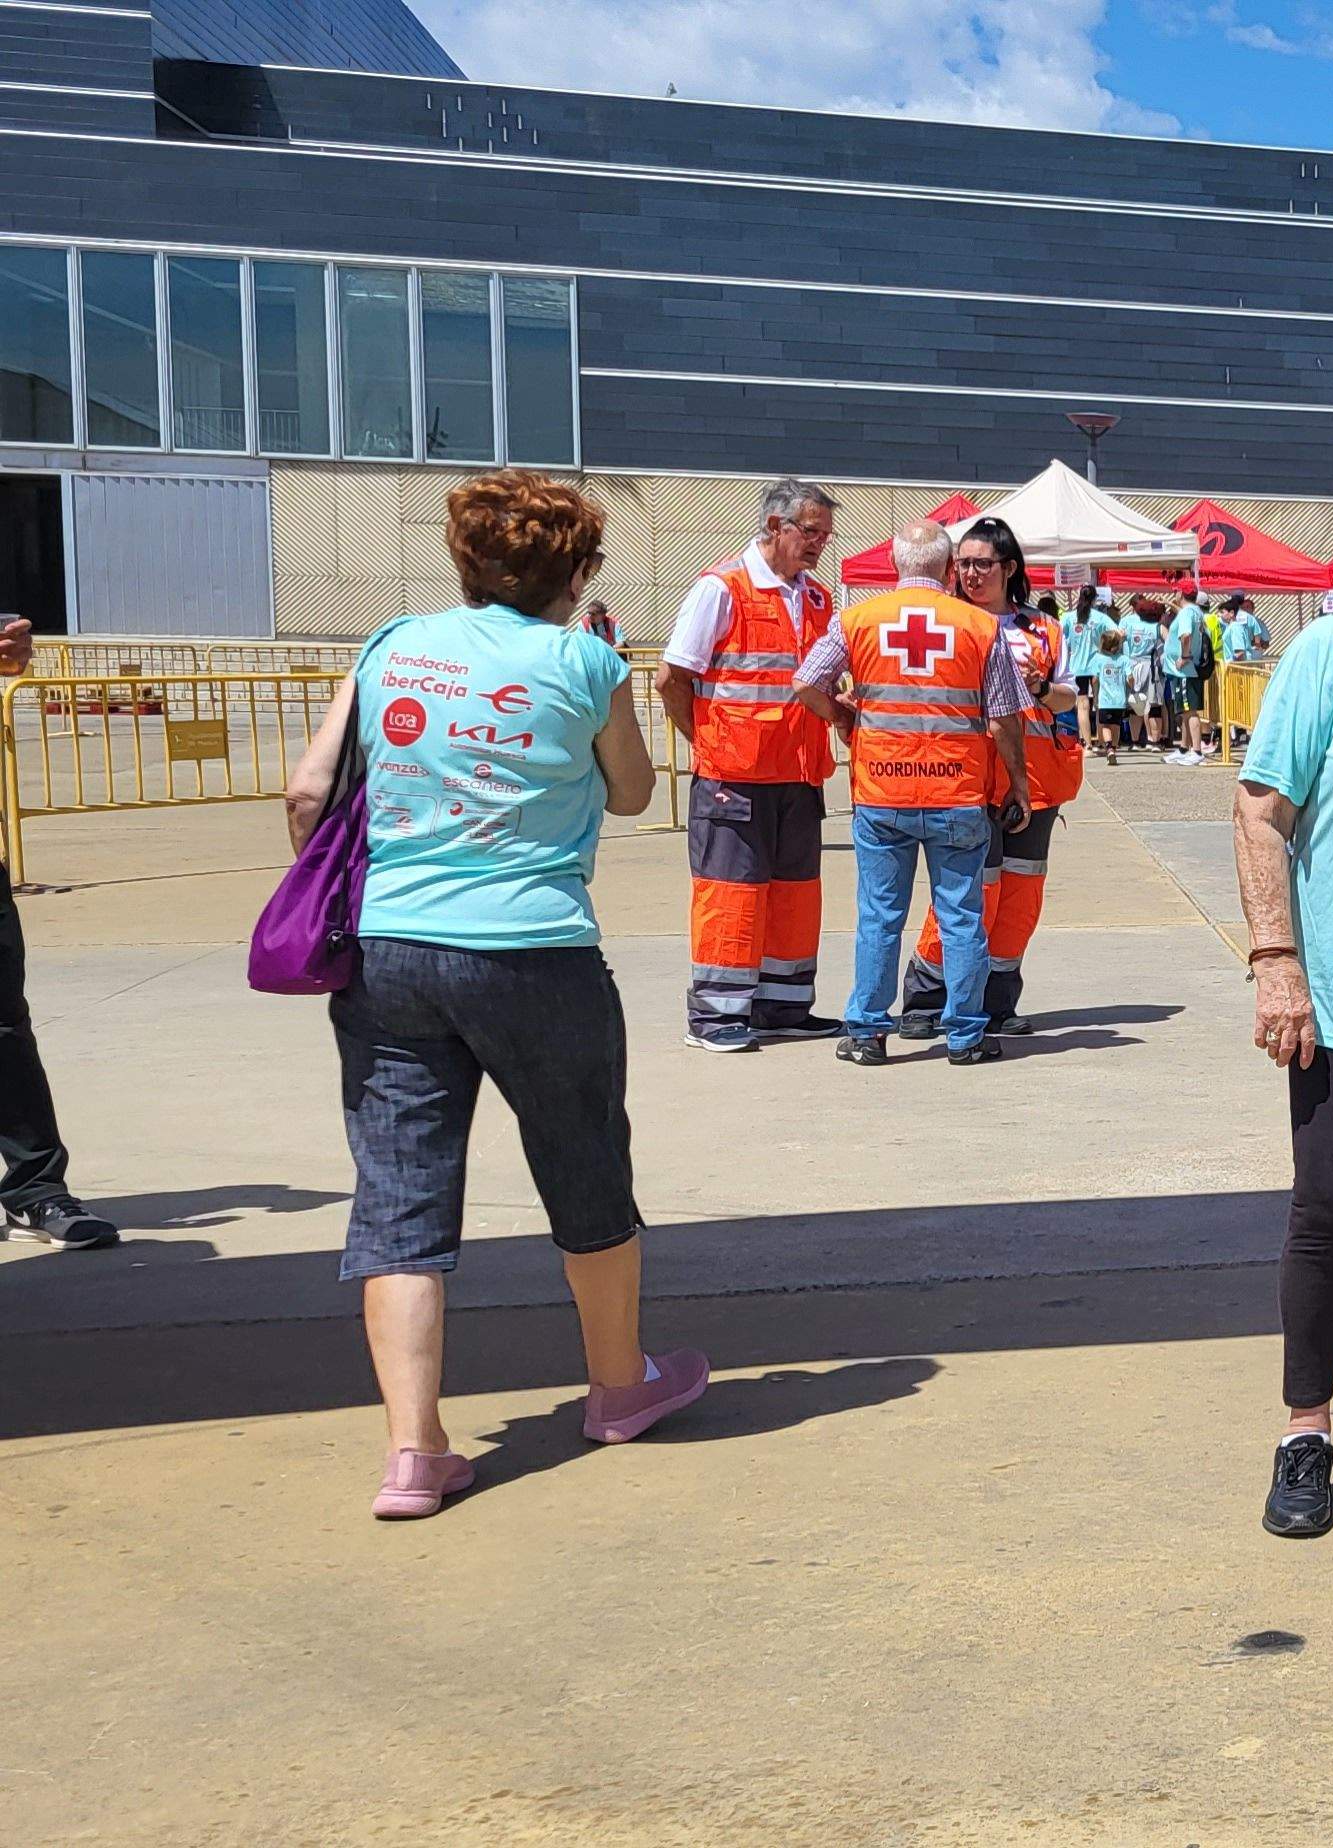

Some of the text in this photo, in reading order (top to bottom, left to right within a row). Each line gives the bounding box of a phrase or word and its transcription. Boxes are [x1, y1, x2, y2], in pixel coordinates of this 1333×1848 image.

[388, 652, 469, 675] Fundación
[377, 762, 418, 775] vanza
[868, 761, 964, 778] COORDINADOR
[442, 776, 522, 795] escanero
